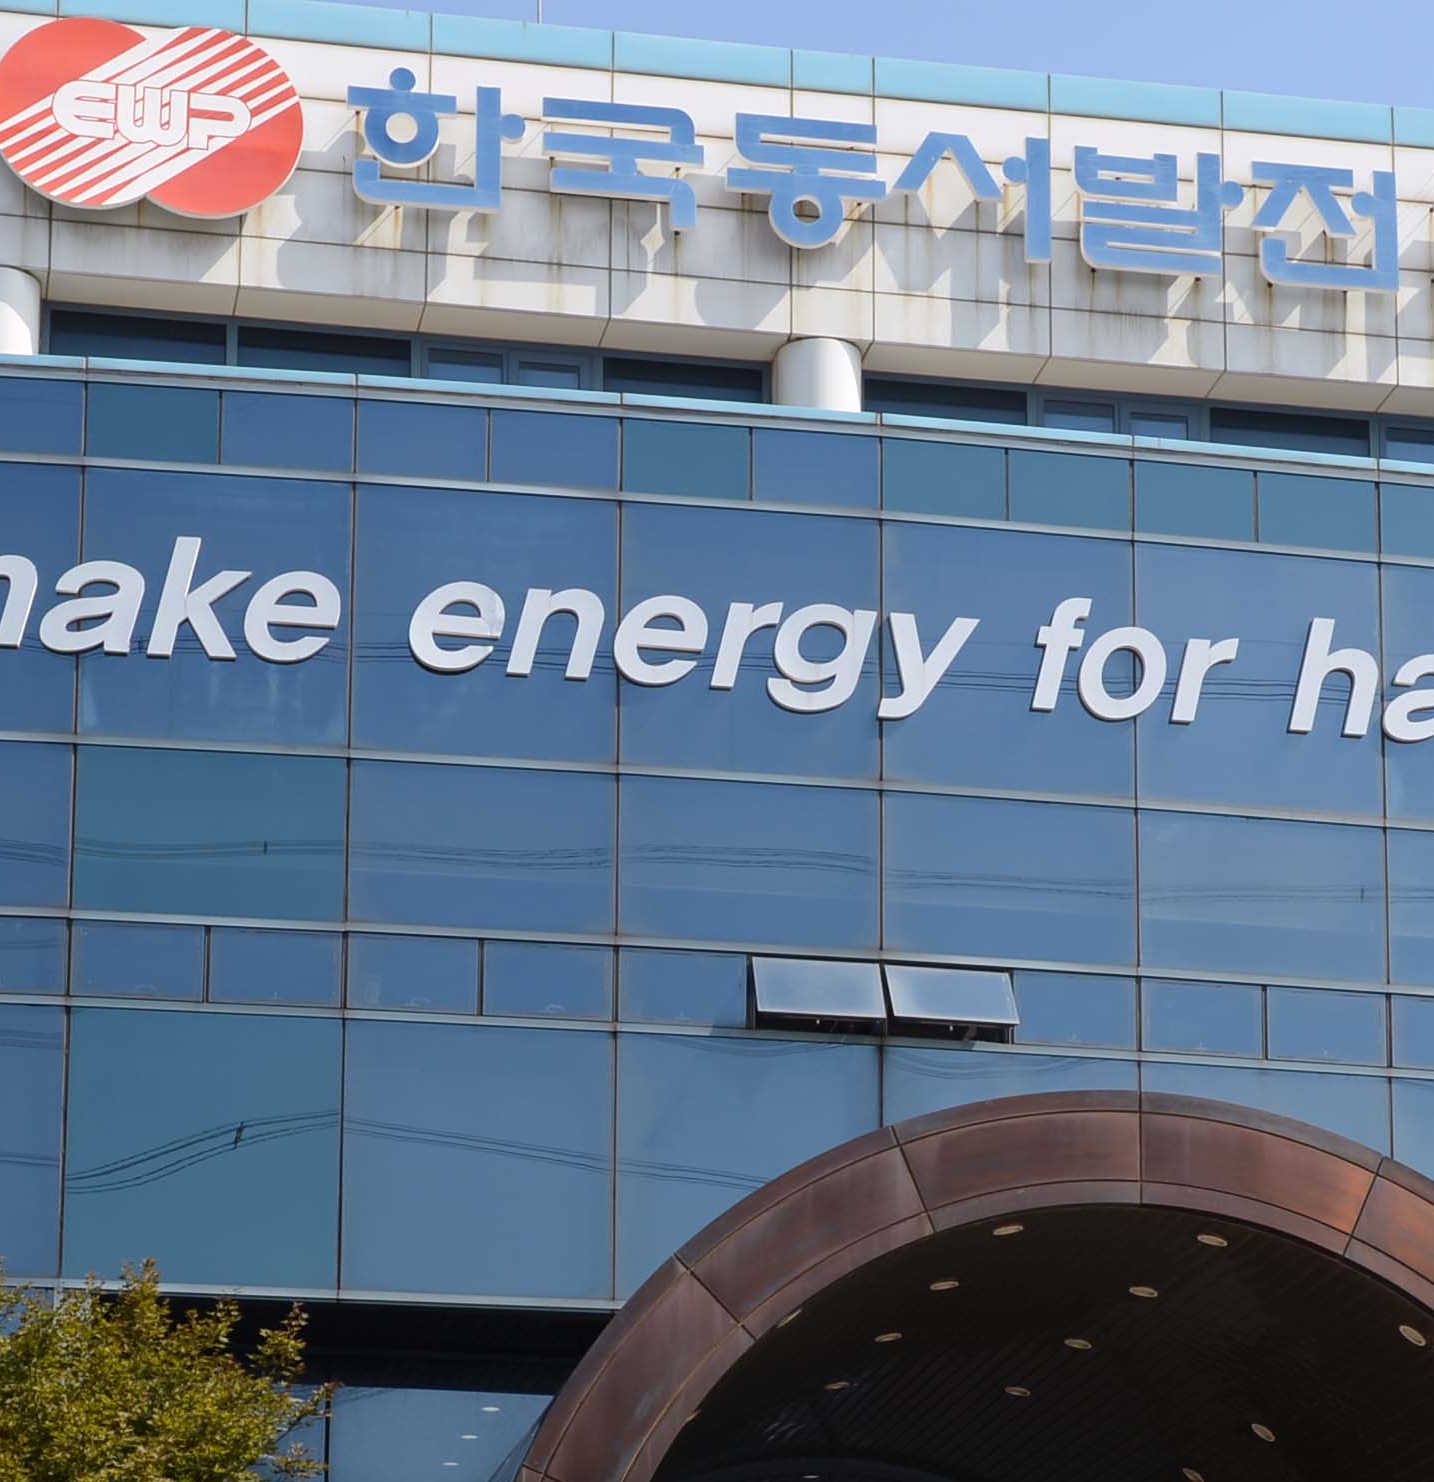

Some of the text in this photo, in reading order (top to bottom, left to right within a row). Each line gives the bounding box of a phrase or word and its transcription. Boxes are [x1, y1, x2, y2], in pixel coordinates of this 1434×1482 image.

[51, 77, 252, 152] EWP
[347, 67, 1399, 292] 한국동서발전
[408, 580, 980, 721] energy
[1031, 597, 1239, 725] for
